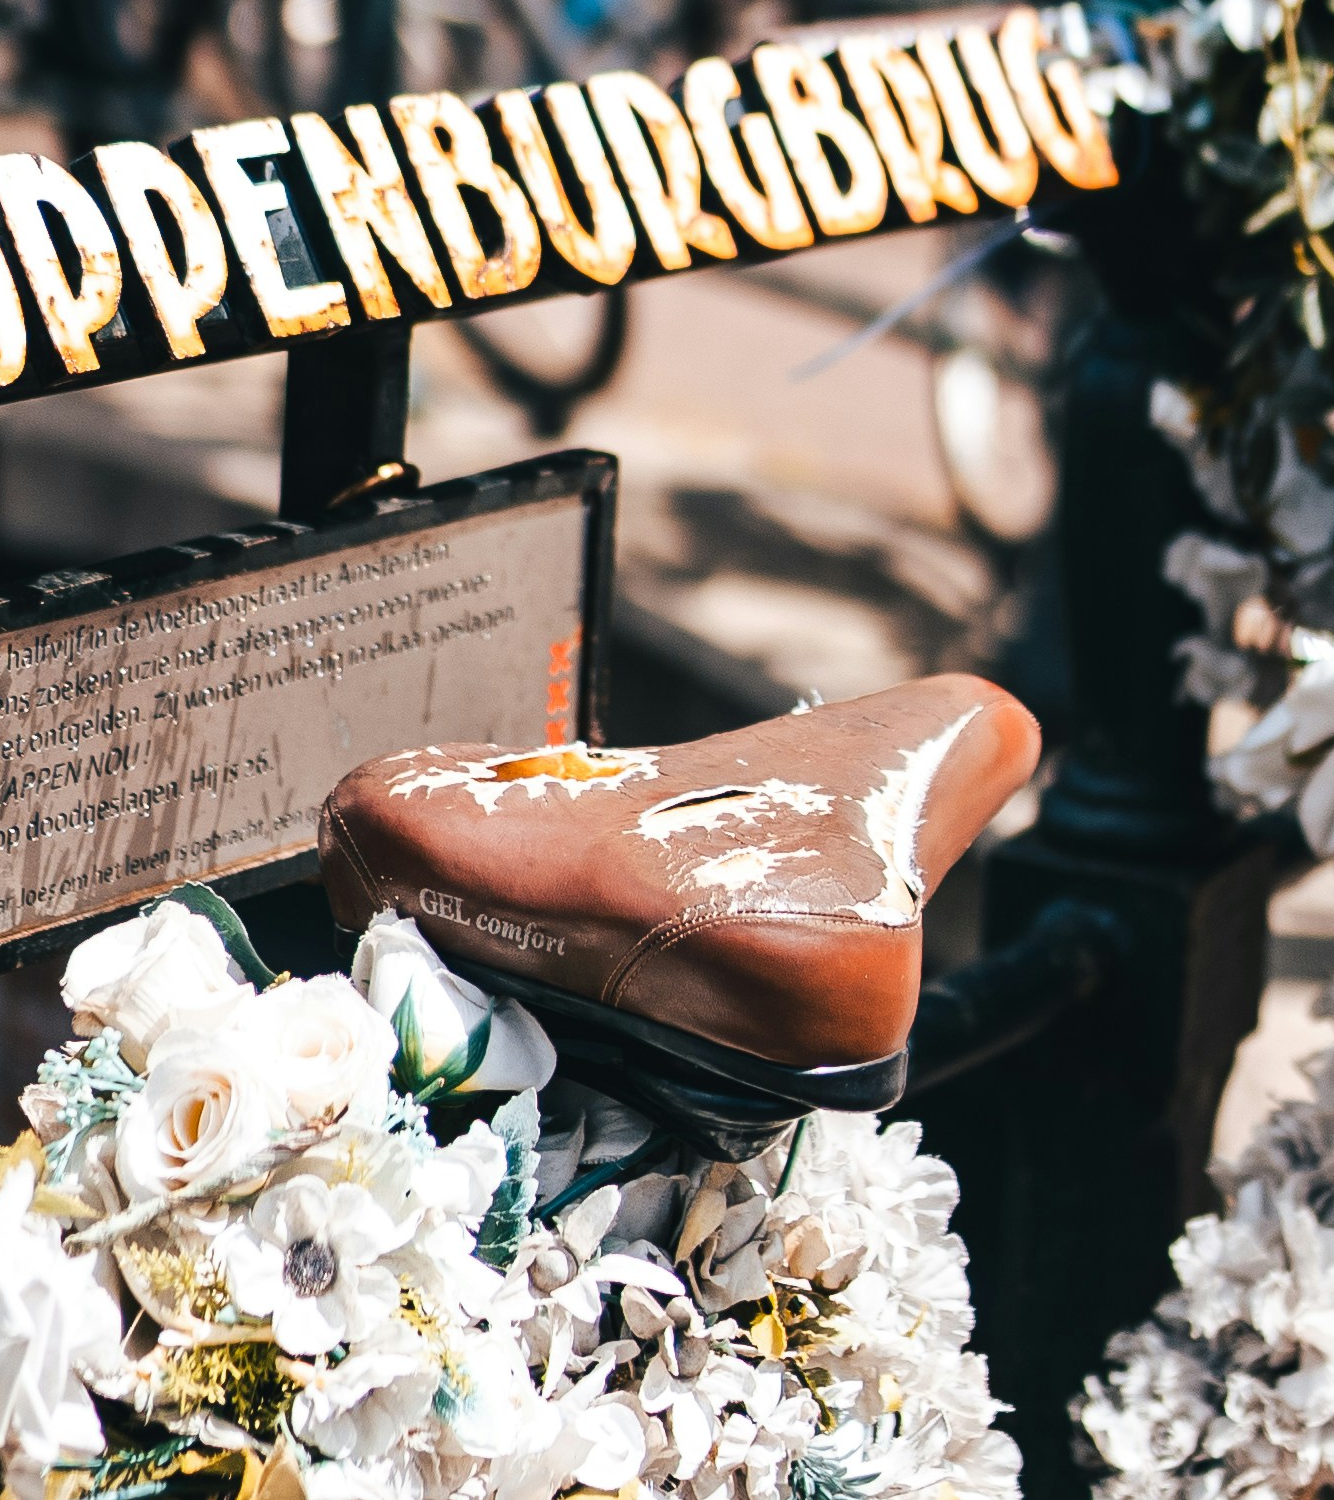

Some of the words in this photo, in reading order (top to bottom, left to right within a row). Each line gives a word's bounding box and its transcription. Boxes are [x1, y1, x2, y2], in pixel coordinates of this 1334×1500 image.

[36, 668, 113, 708] zoeken
[119, 654, 171, 688] ruzie
[175, 639, 216, 669] met
[349, 602, 373, 627] en
[377, 592, 411, 617] een
[89, 623, 108, 651] in
[114, 613, 140, 646] de
[145, 575, 308, 633] Voetboogstraat
[312, 570, 333, 595] te
[30, 703, 147, 753] ontgelden.
[154, 689, 179, 726] Zij
[184, 672, 261, 709] worden
[267, 651, 344, 688] volledig
[26, 779, 184, 842] doodgeslagen.
[190, 763, 218, 798] Hij
[223, 762, 239, 784] is
[17, 882, 56, 909] Joes
[59, 872, 88, 895] om
[93, 863, 120, 885] het
[125, 850, 171, 878] leven
[419, 887, 471, 926] GEL
[476, 911, 565, 956] comfort
